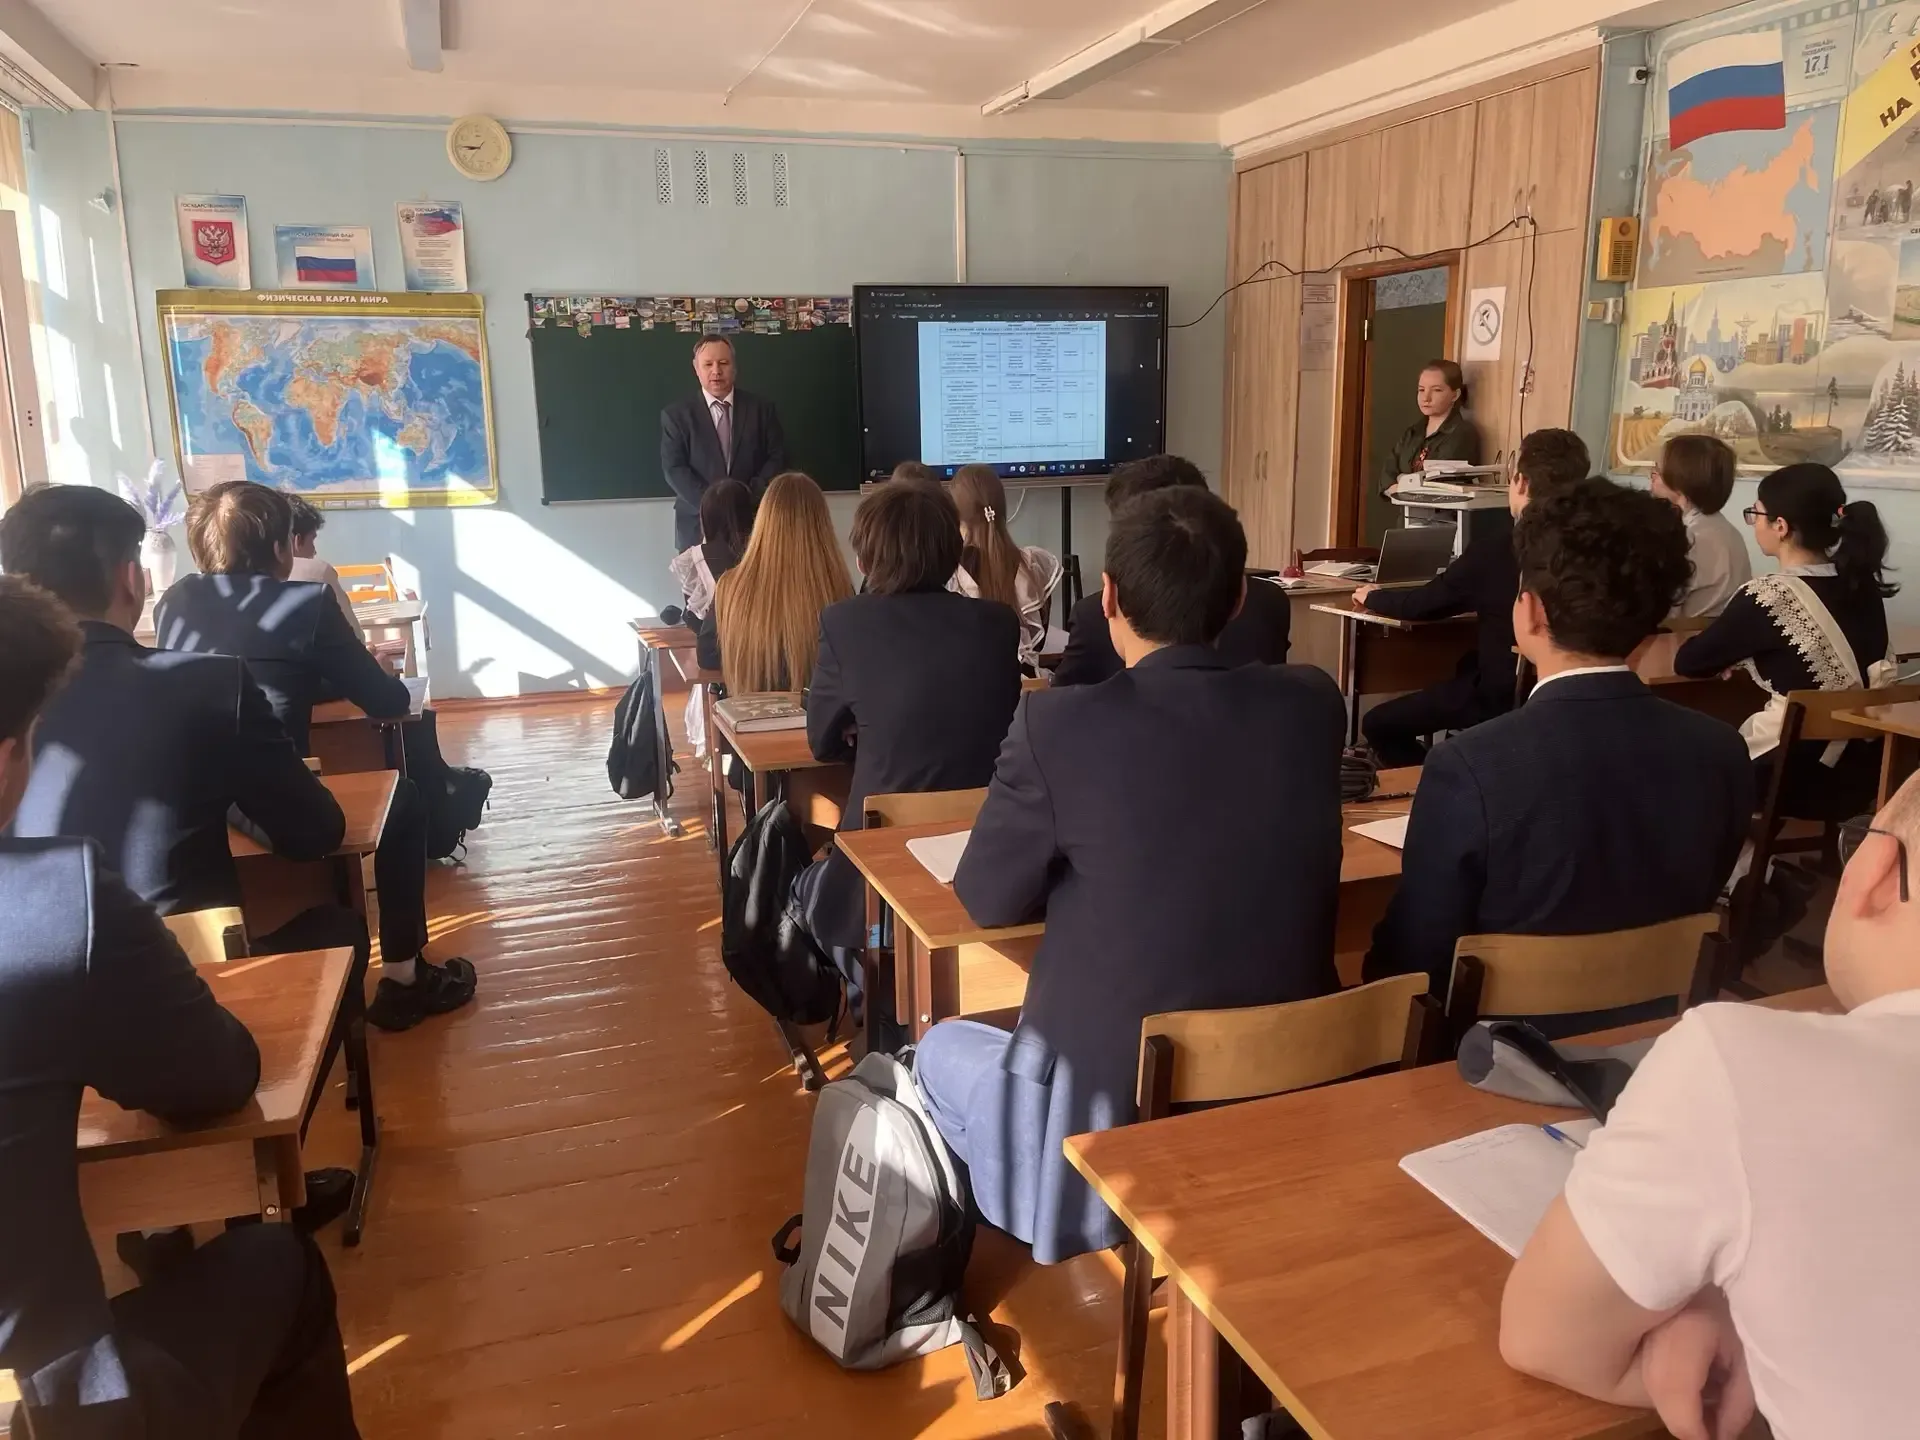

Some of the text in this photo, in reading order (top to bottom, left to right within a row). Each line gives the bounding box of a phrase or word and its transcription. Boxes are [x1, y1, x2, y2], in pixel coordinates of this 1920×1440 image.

[1879, 97, 1913, 128] НА
[257, 293, 389, 304] ФИЗИЧЕСКАЯ КАРТА МИРА
[814, 1142, 876, 1331] NIKE
